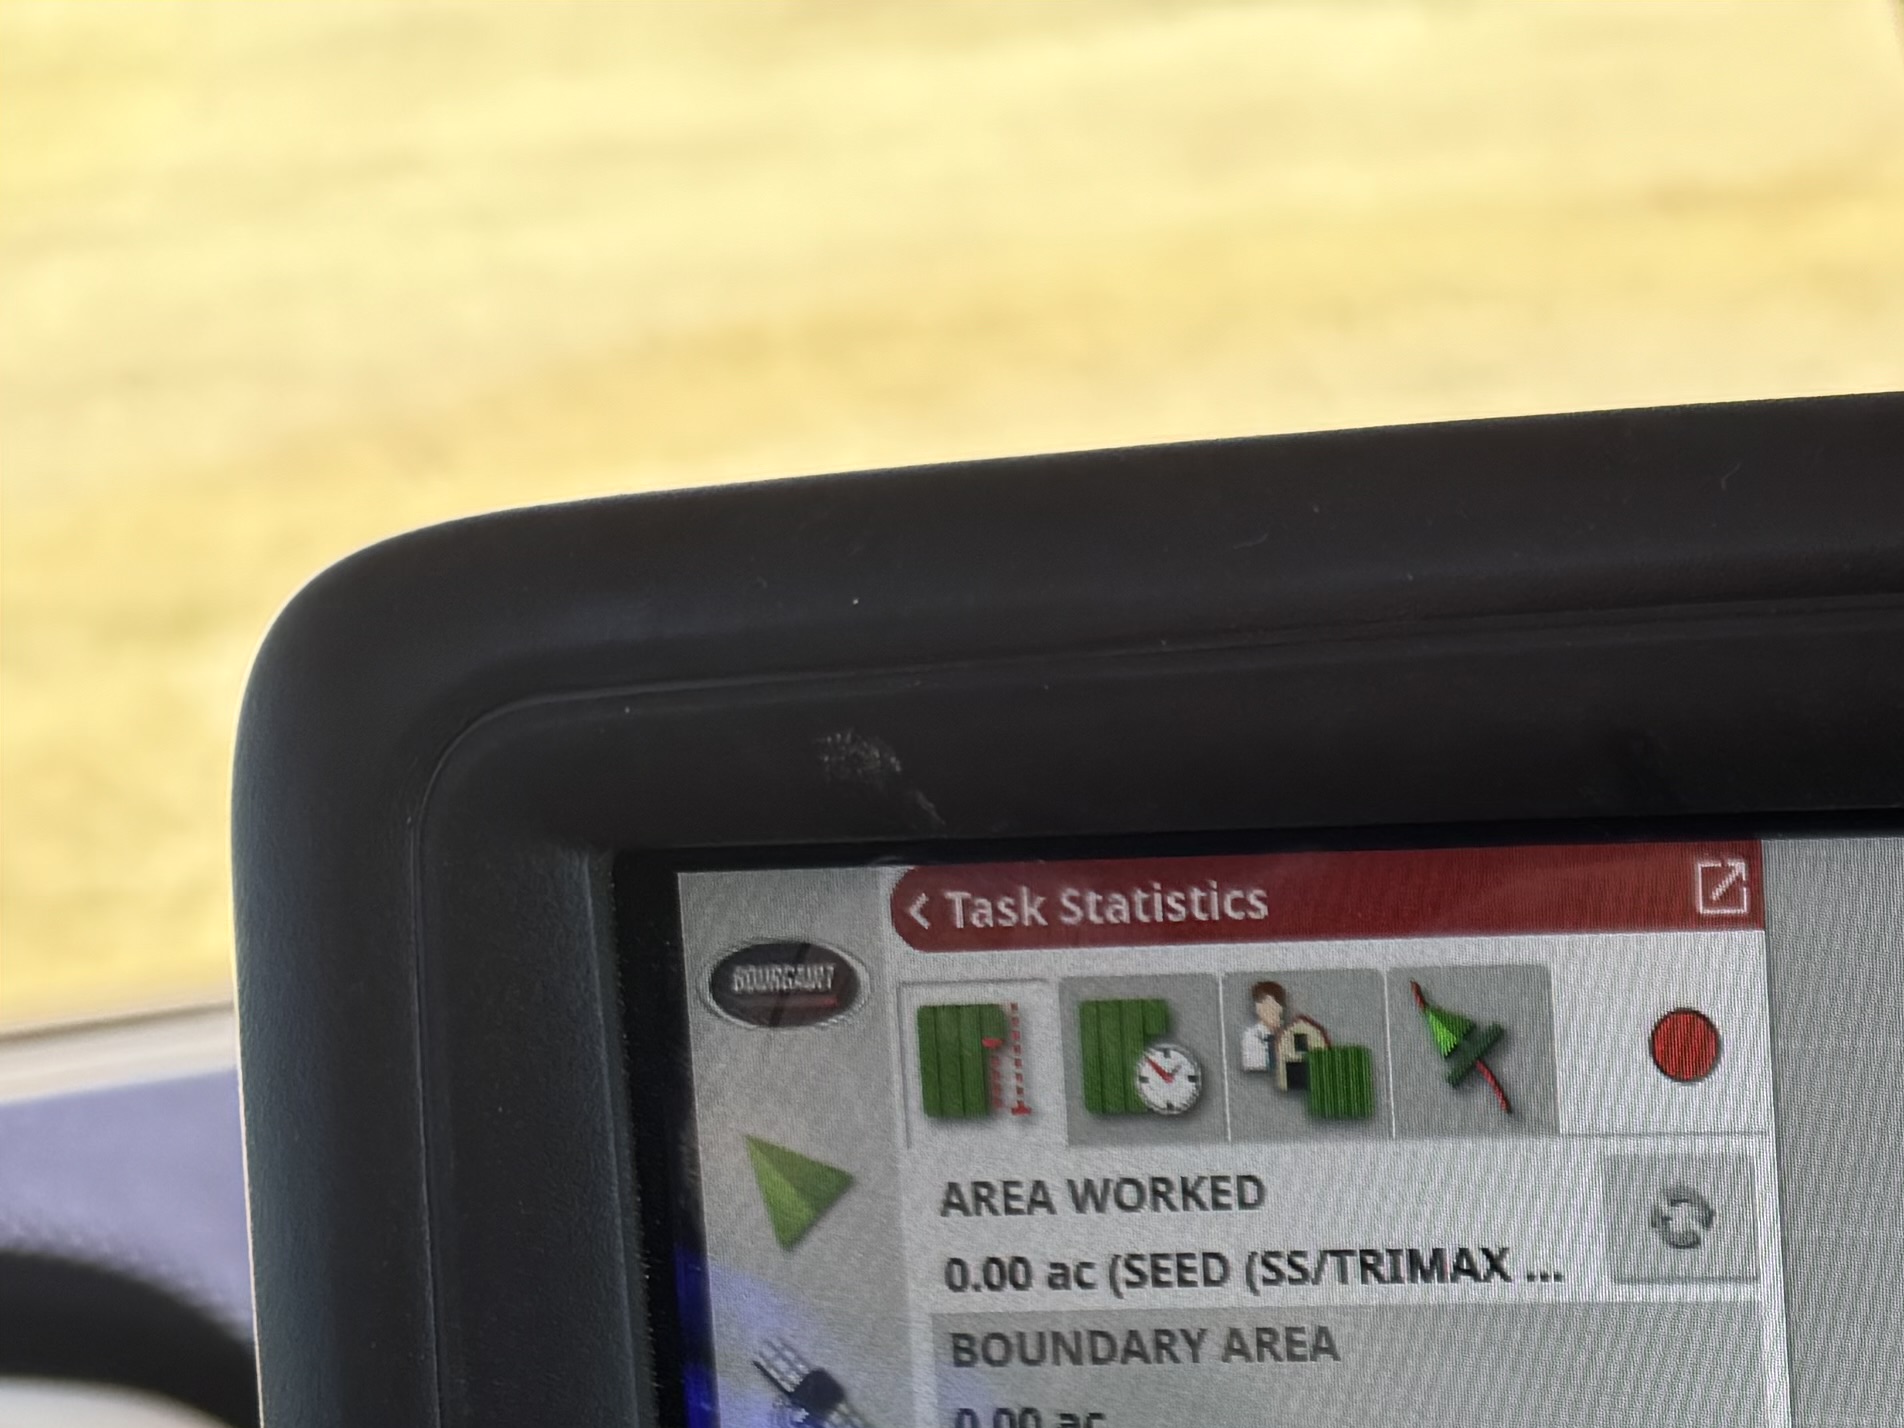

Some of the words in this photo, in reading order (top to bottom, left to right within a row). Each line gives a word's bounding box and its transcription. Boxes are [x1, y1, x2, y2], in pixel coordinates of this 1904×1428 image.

[946, 890, 1047, 931] Task
[1059, 886, 1269, 925] Statistics
[941, 1180, 1054, 1218] AREA
[1068, 1175, 1266, 1214] WORKED
[946, 1257, 1032, 1292] 0.00
[1047, 1261, 1096, 1291] ac
[1108, 1253, 1231, 1296] (SEED
[1244, 1248, 1512, 1294] (SS/TRIMAX
[951, 1329, 1208, 1368] BOUNDARY
[1222, 1327, 1340, 1363] AREA
